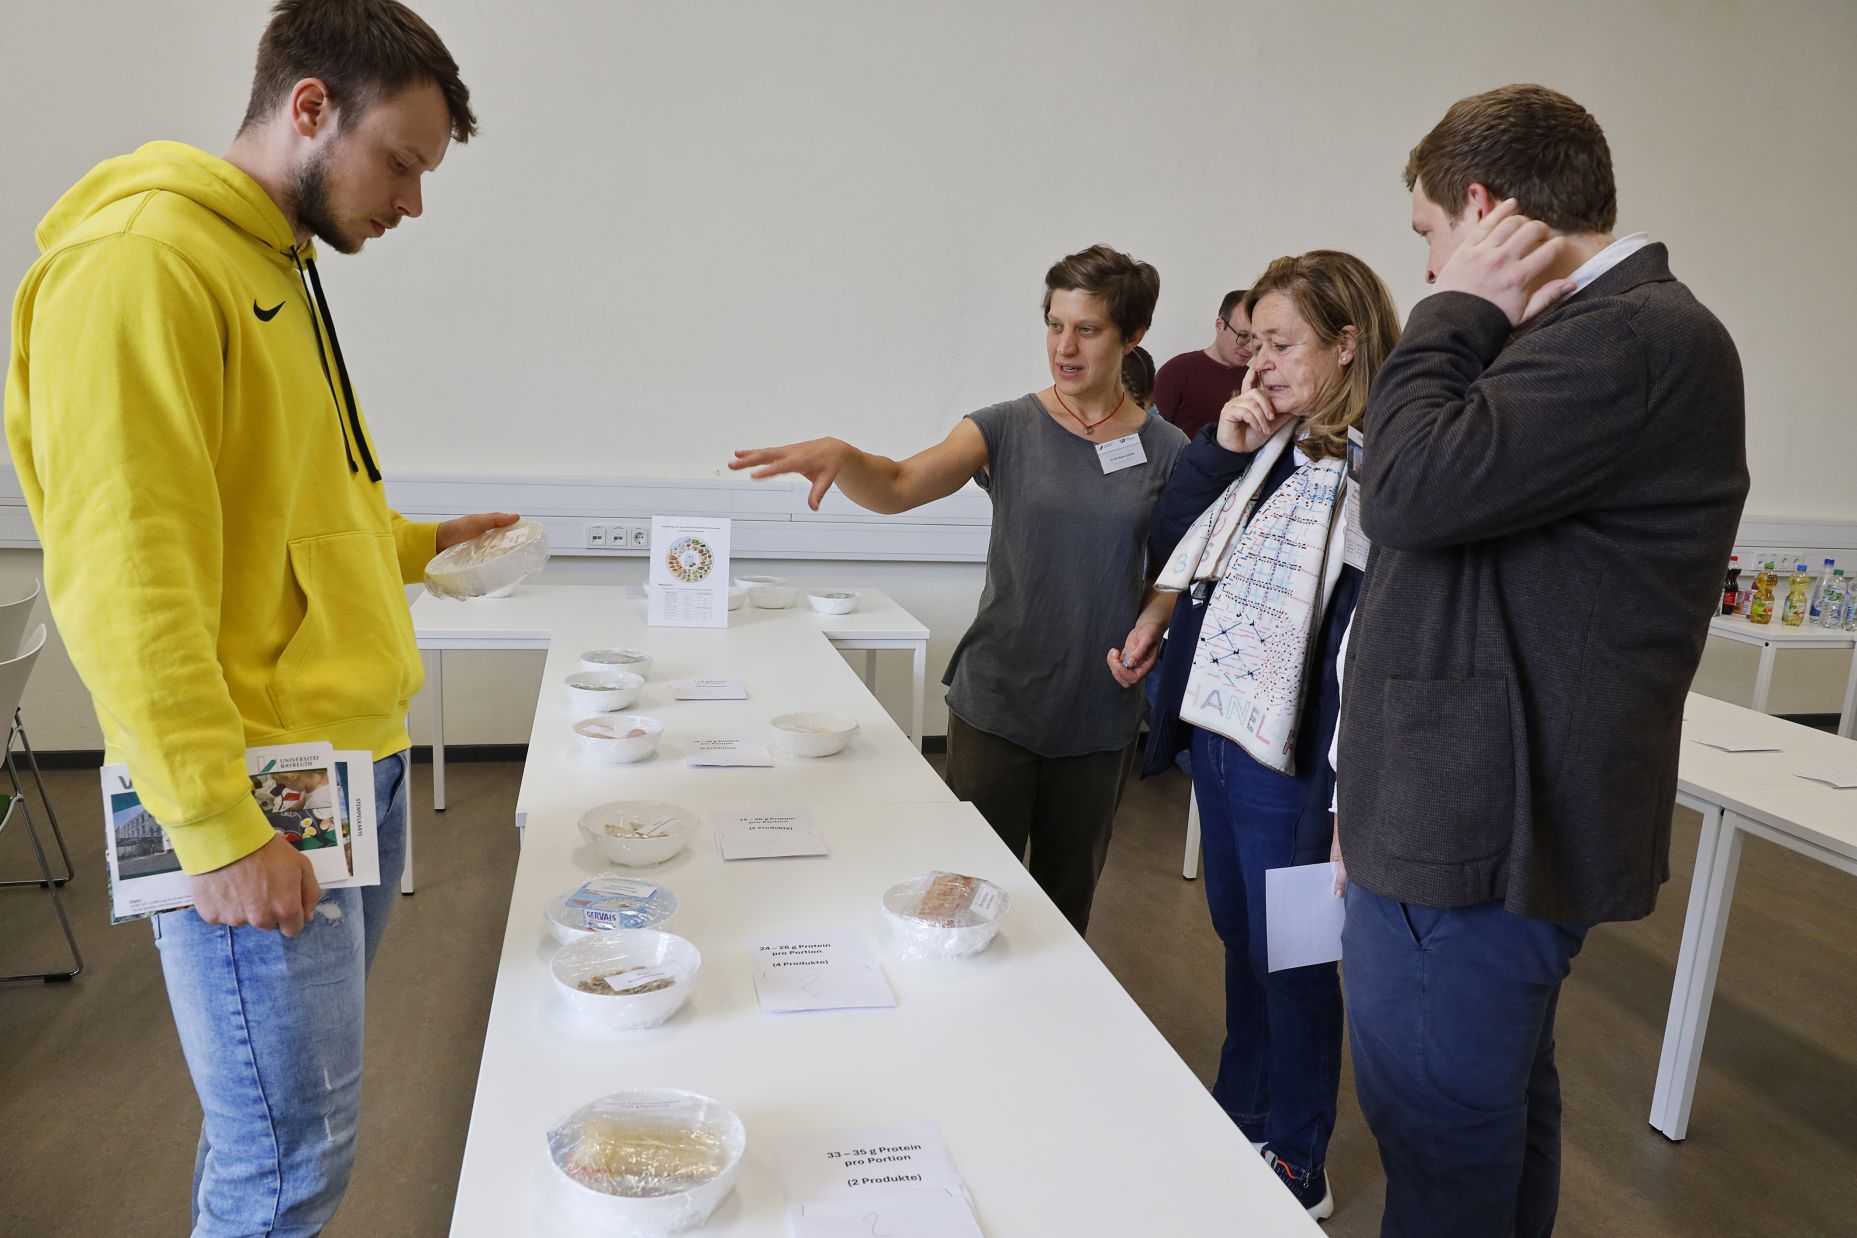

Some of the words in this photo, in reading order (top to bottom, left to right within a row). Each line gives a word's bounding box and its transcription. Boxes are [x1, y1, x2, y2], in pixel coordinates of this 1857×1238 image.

[586, 911, 617, 922] GERVAIS
[852, 1148, 867, 1156] 35
[869, 1148, 877, 1156] g
[879, 1144, 921, 1153] Protein
[867, 1155, 911, 1164] Portion
[847, 1178, 859, 1187] (2
[861, 1173, 922, 1184] Produkte)
